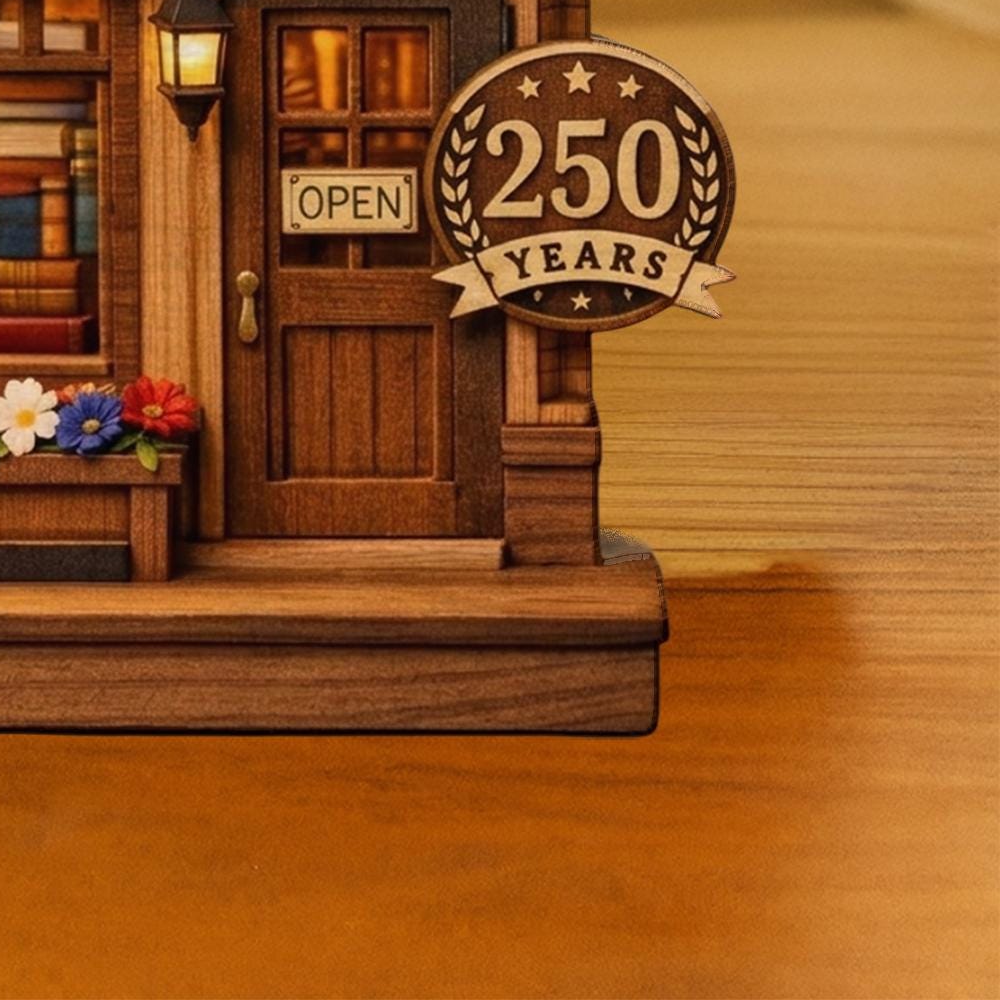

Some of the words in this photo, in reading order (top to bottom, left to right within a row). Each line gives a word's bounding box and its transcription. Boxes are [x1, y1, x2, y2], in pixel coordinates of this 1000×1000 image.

[482, 118, 681, 220] 250
[298, 184, 402, 220] OPEN
[503, 240, 668, 281] YEARS
